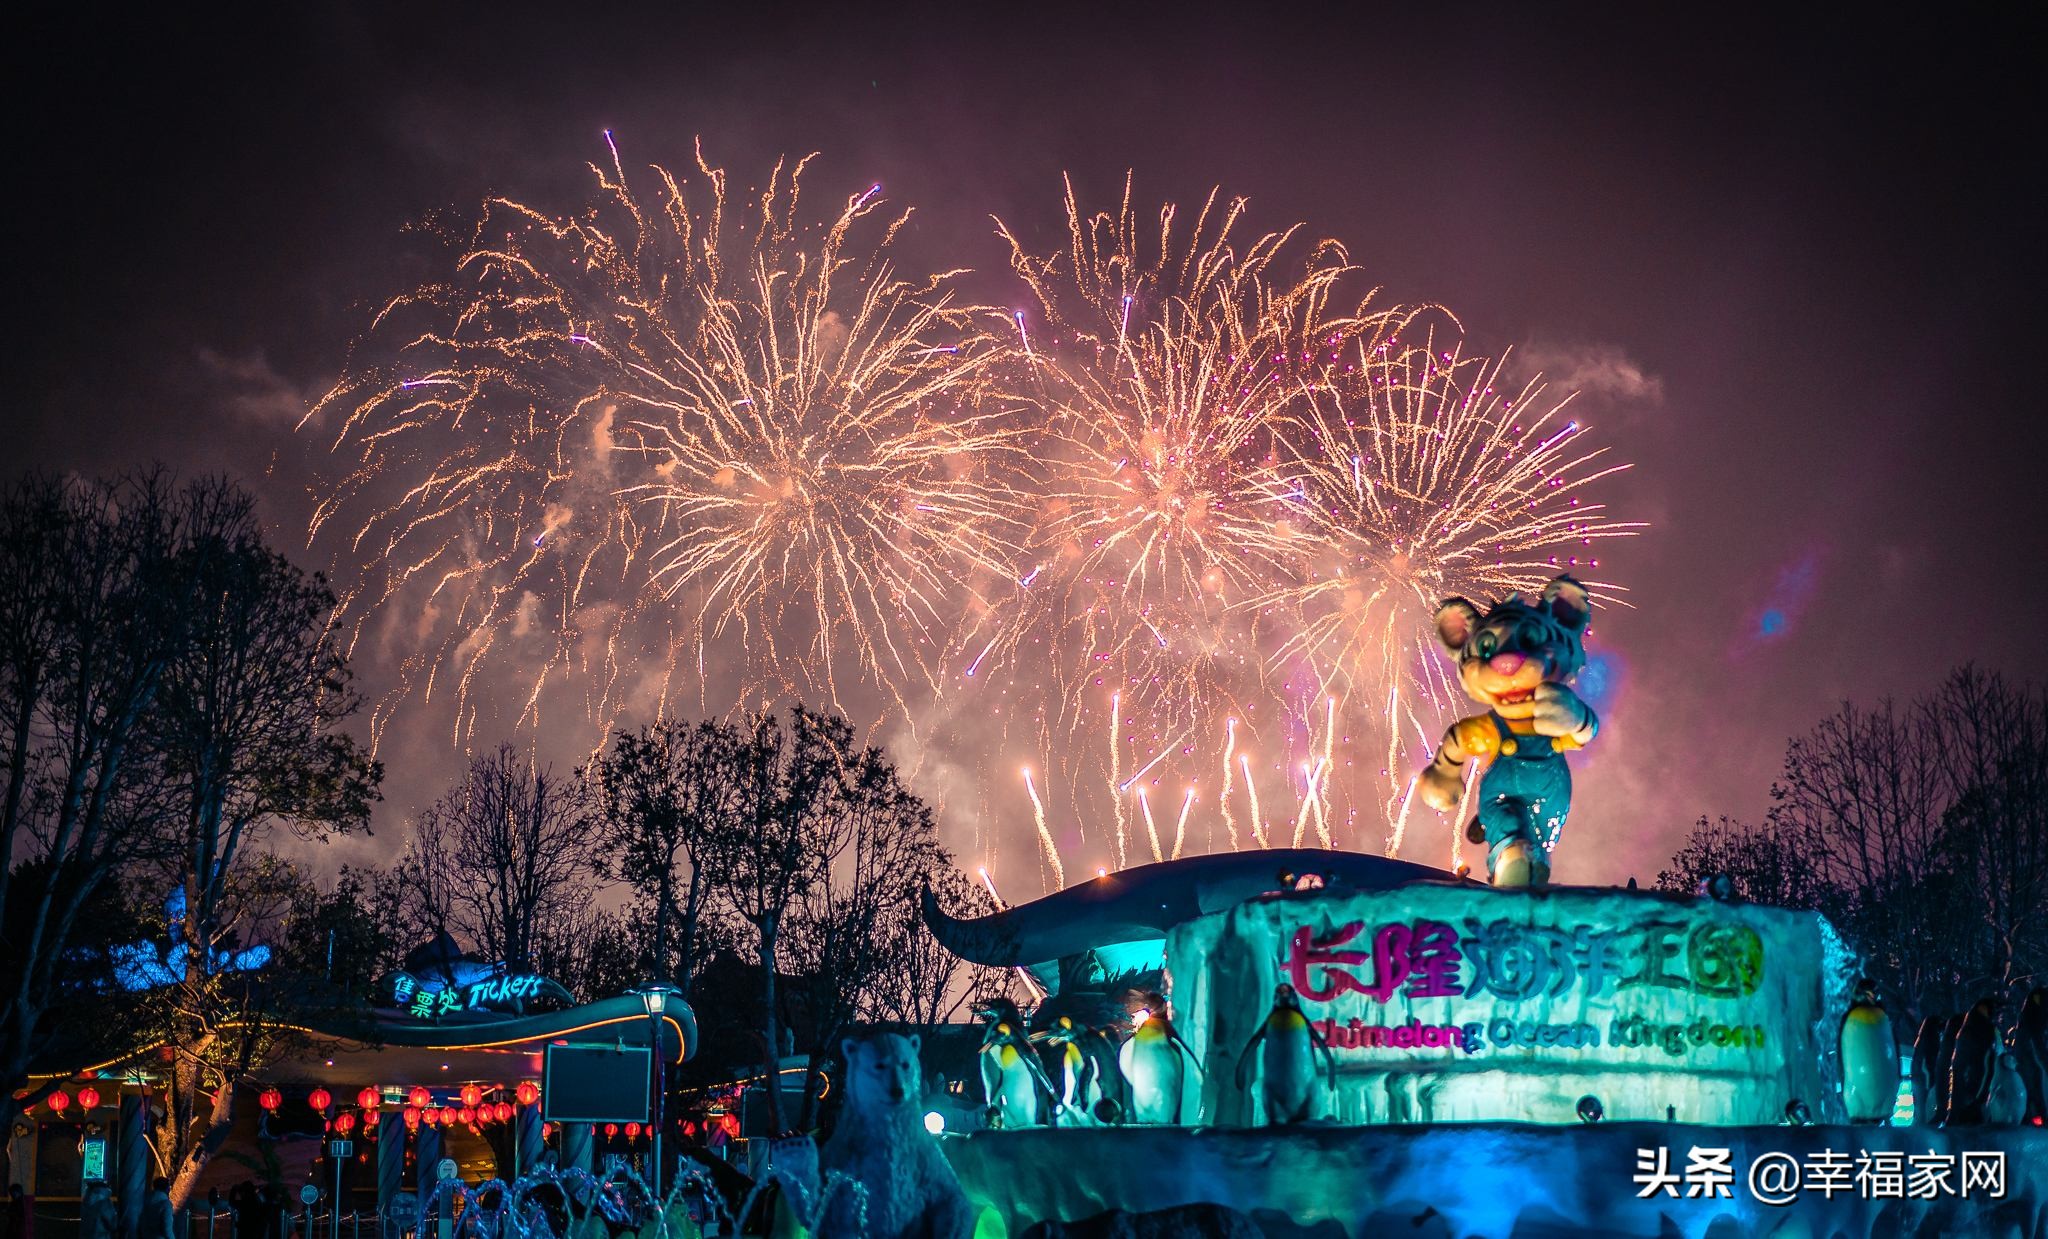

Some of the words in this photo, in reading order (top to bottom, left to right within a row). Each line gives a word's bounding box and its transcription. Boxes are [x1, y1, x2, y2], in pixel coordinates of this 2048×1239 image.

[1280, 916, 1765, 1004] 长隆海洋王国
[394, 975, 463, 1018] 售票处
[468, 973, 545, 1008] Tickets
[1488, 1017, 1600, 1049] Ocean
[1608, 1014, 1765, 1057] Kingdom
